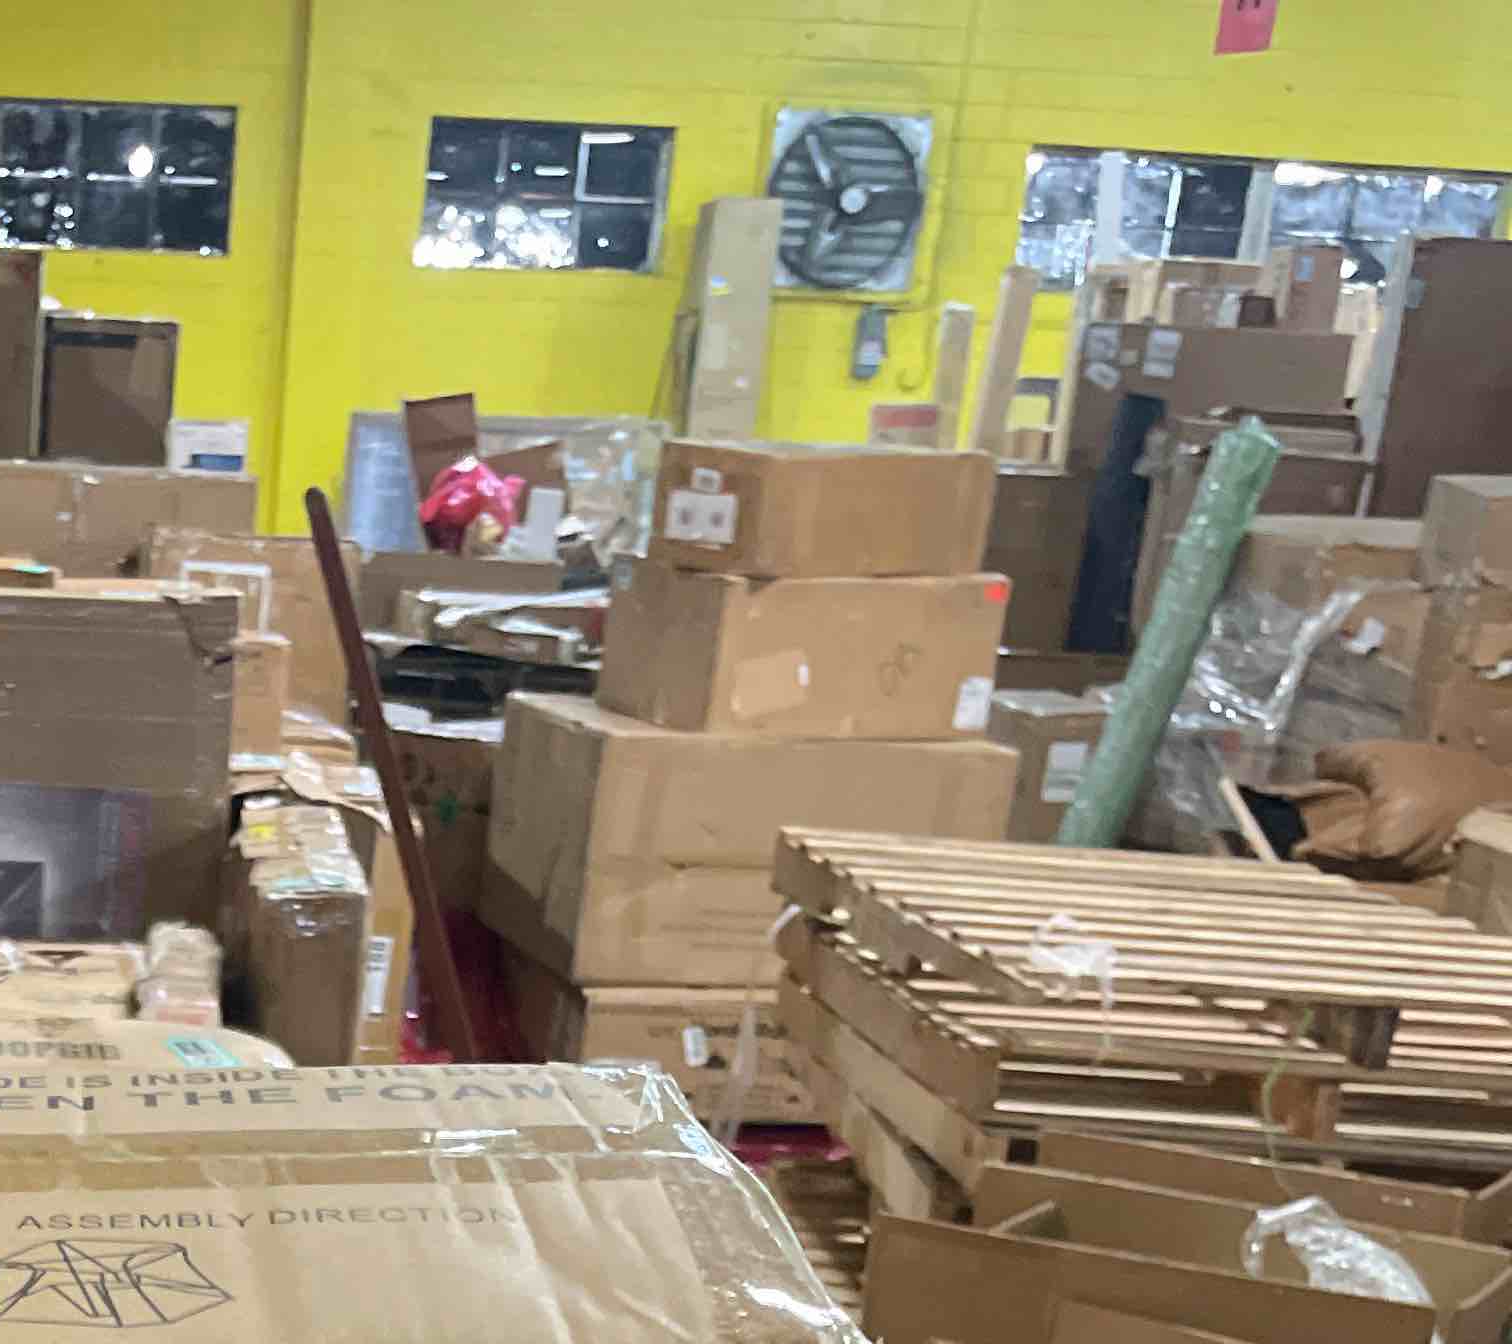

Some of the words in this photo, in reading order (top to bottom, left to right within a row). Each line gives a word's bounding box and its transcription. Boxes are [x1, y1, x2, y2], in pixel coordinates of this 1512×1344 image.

[66, 1074, 112, 1089] IS
[131, 1068, 303, 1087] INSIDE
[126, 1087, 298, 1109] THE
[16, 1212, 254, 1230] ASSEMBLY
